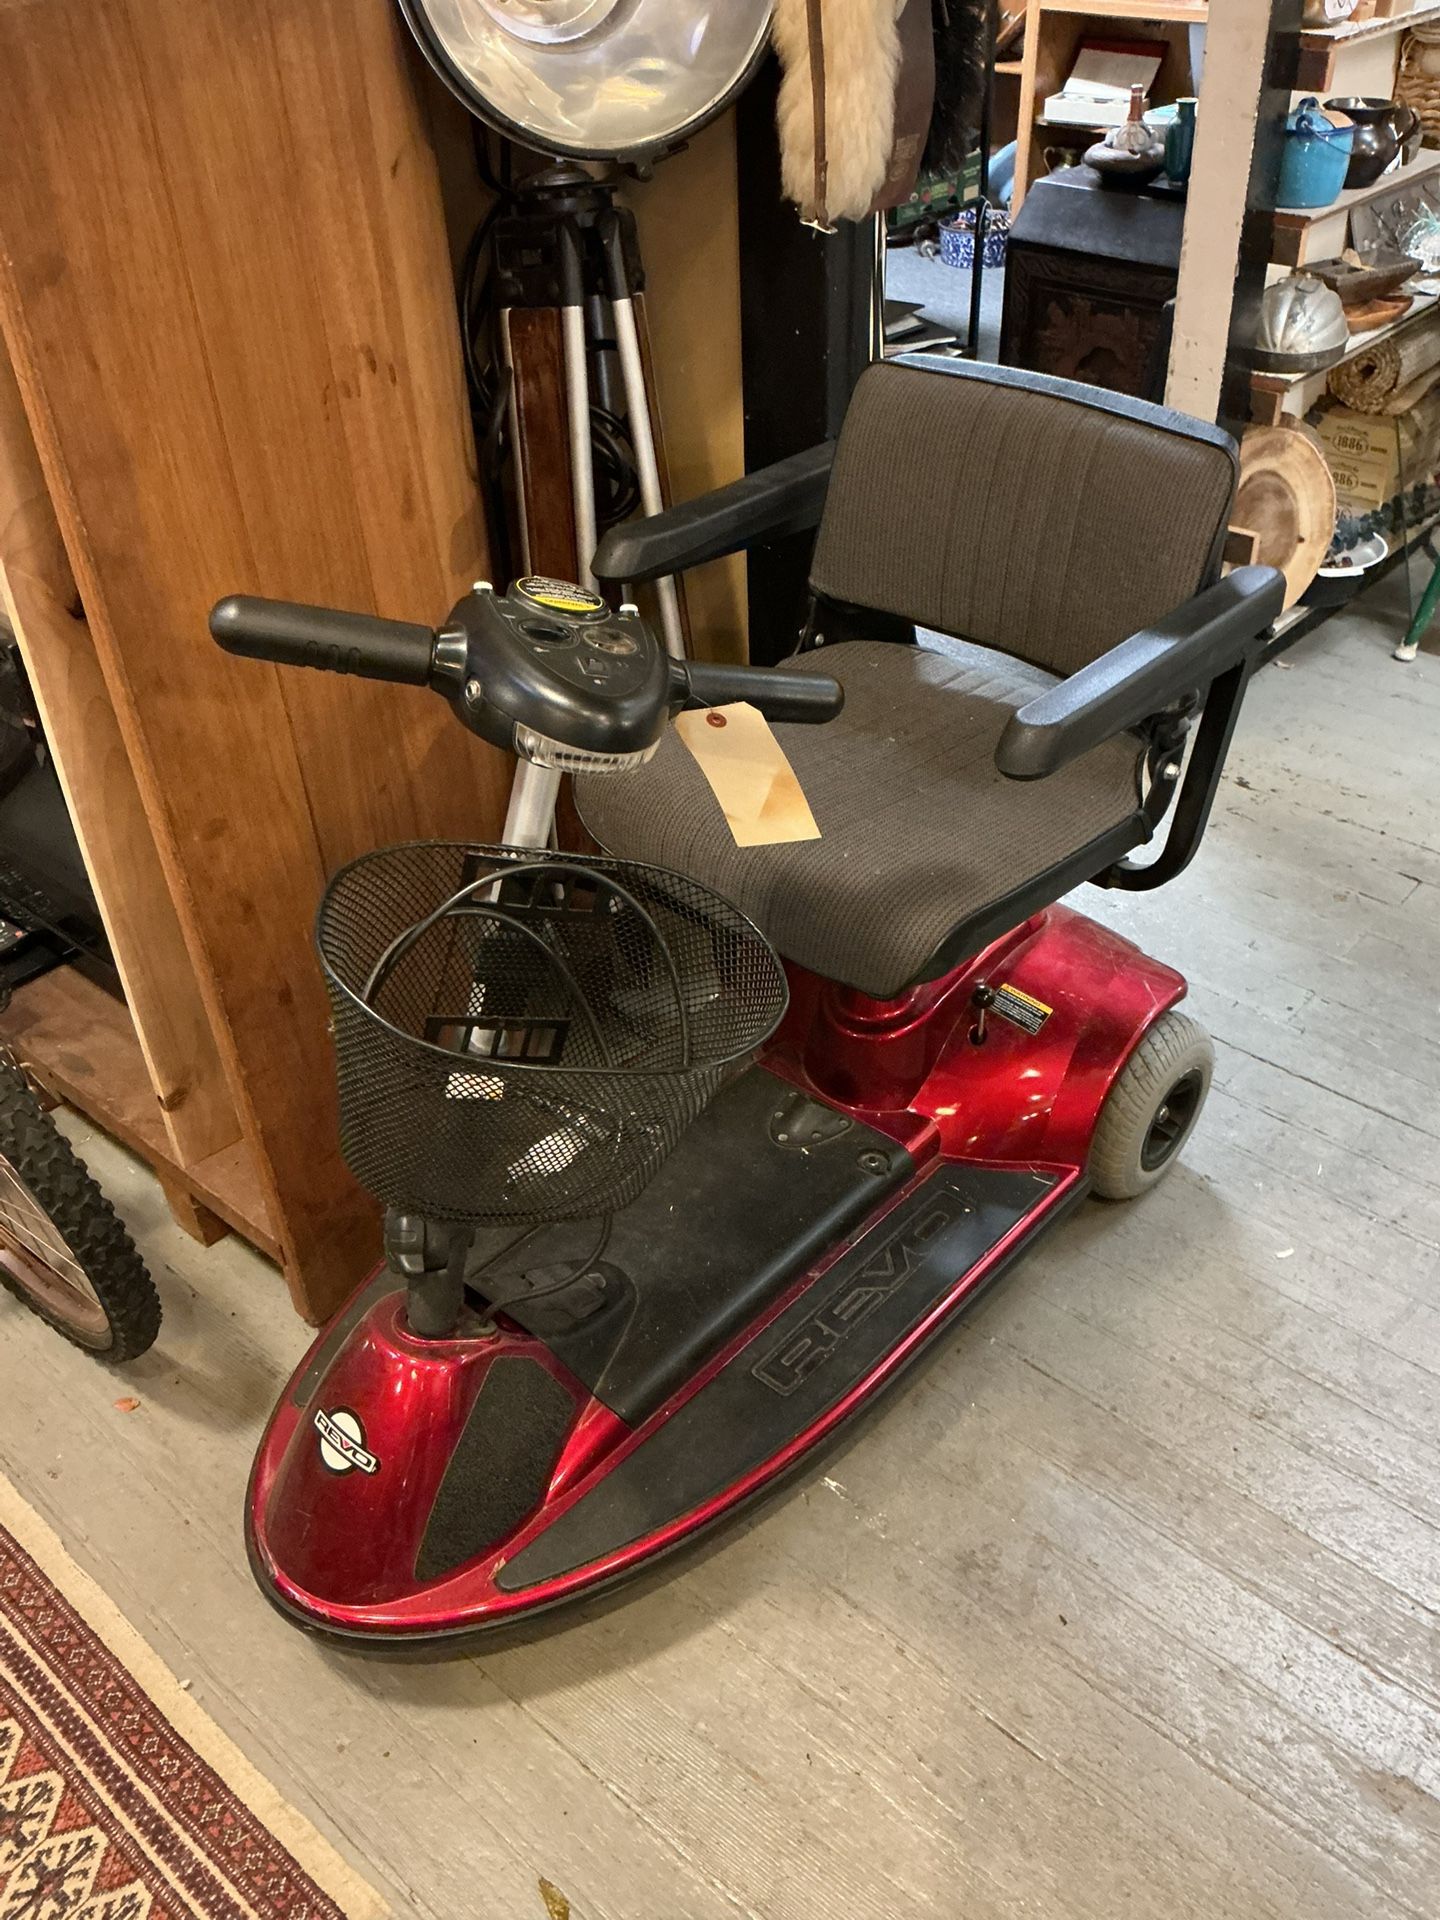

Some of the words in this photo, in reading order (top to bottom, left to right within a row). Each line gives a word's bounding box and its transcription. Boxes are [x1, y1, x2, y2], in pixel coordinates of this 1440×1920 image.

[1337, 435, 1362, 451] 1886
[752, 1190, 974, 1396] REVO
[316, 1414, 372, 1468] REVO
